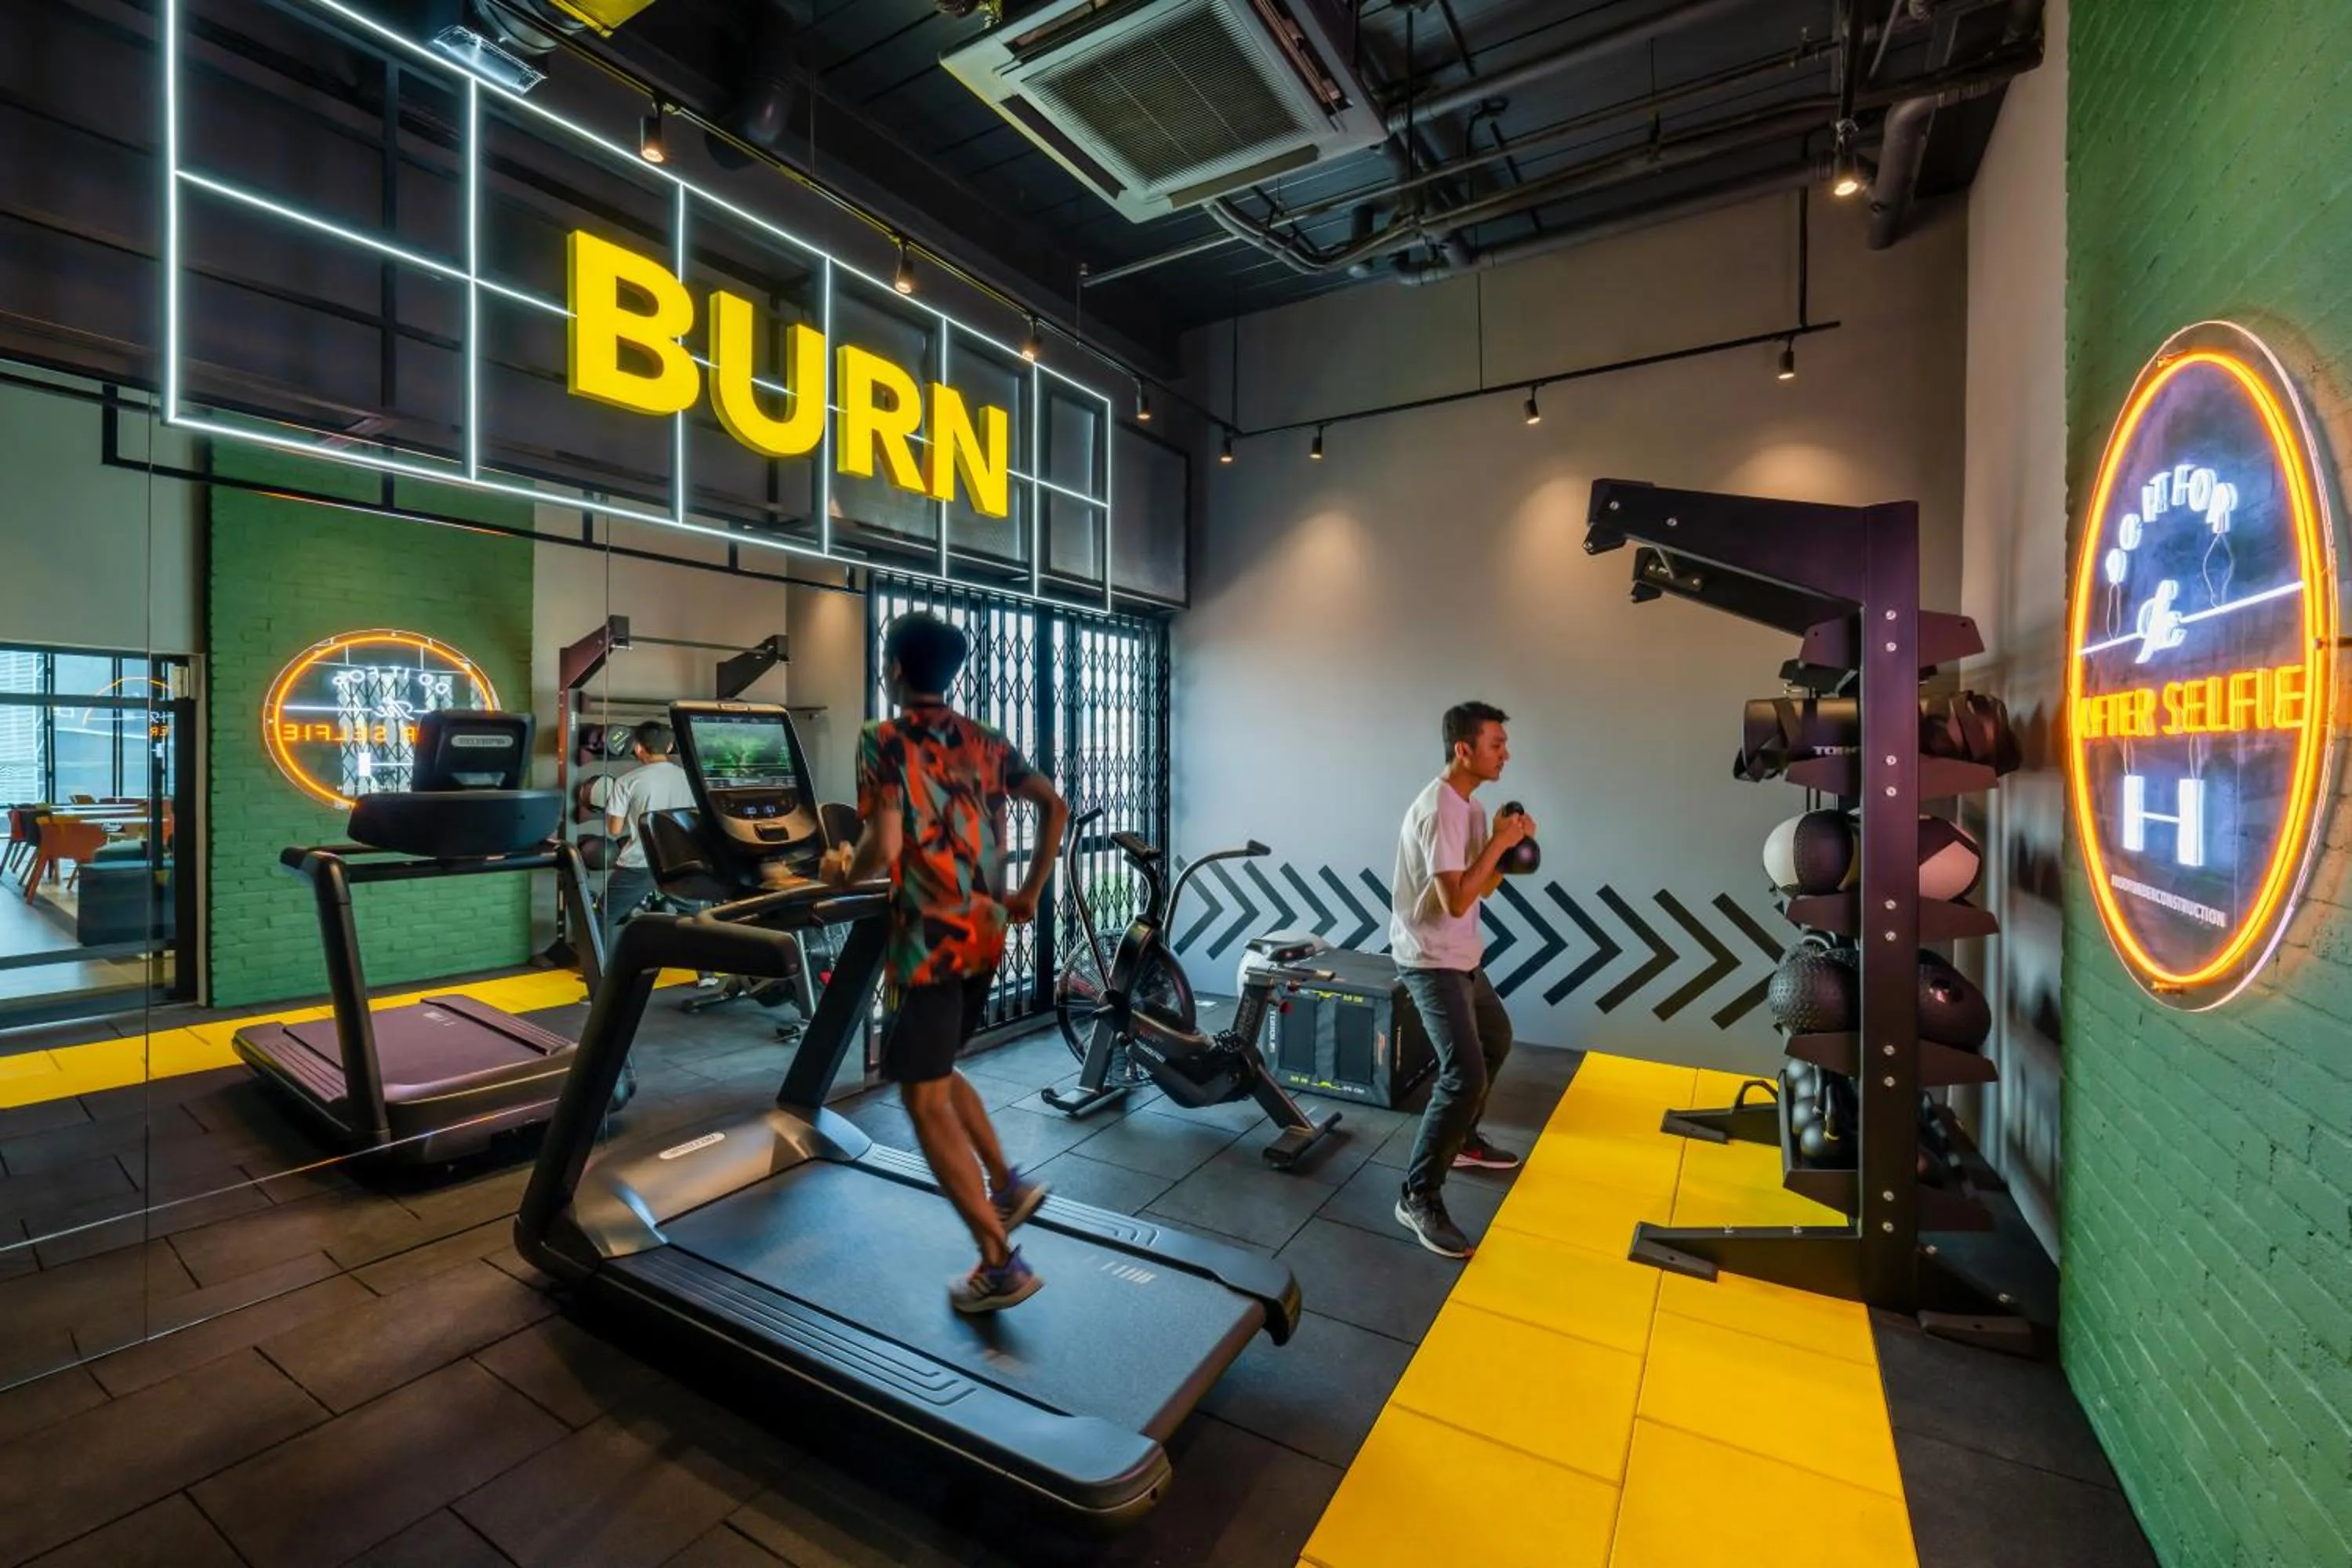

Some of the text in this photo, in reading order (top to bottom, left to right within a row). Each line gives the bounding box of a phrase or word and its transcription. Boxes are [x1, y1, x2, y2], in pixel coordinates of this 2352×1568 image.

[567, 229, 1008, 518] BURN
[2142, 471, 2172, 523] IT
[2171, 463, 2238, 534] FOR
[2079, 665, 2307, 739] AFTER SELFIE
